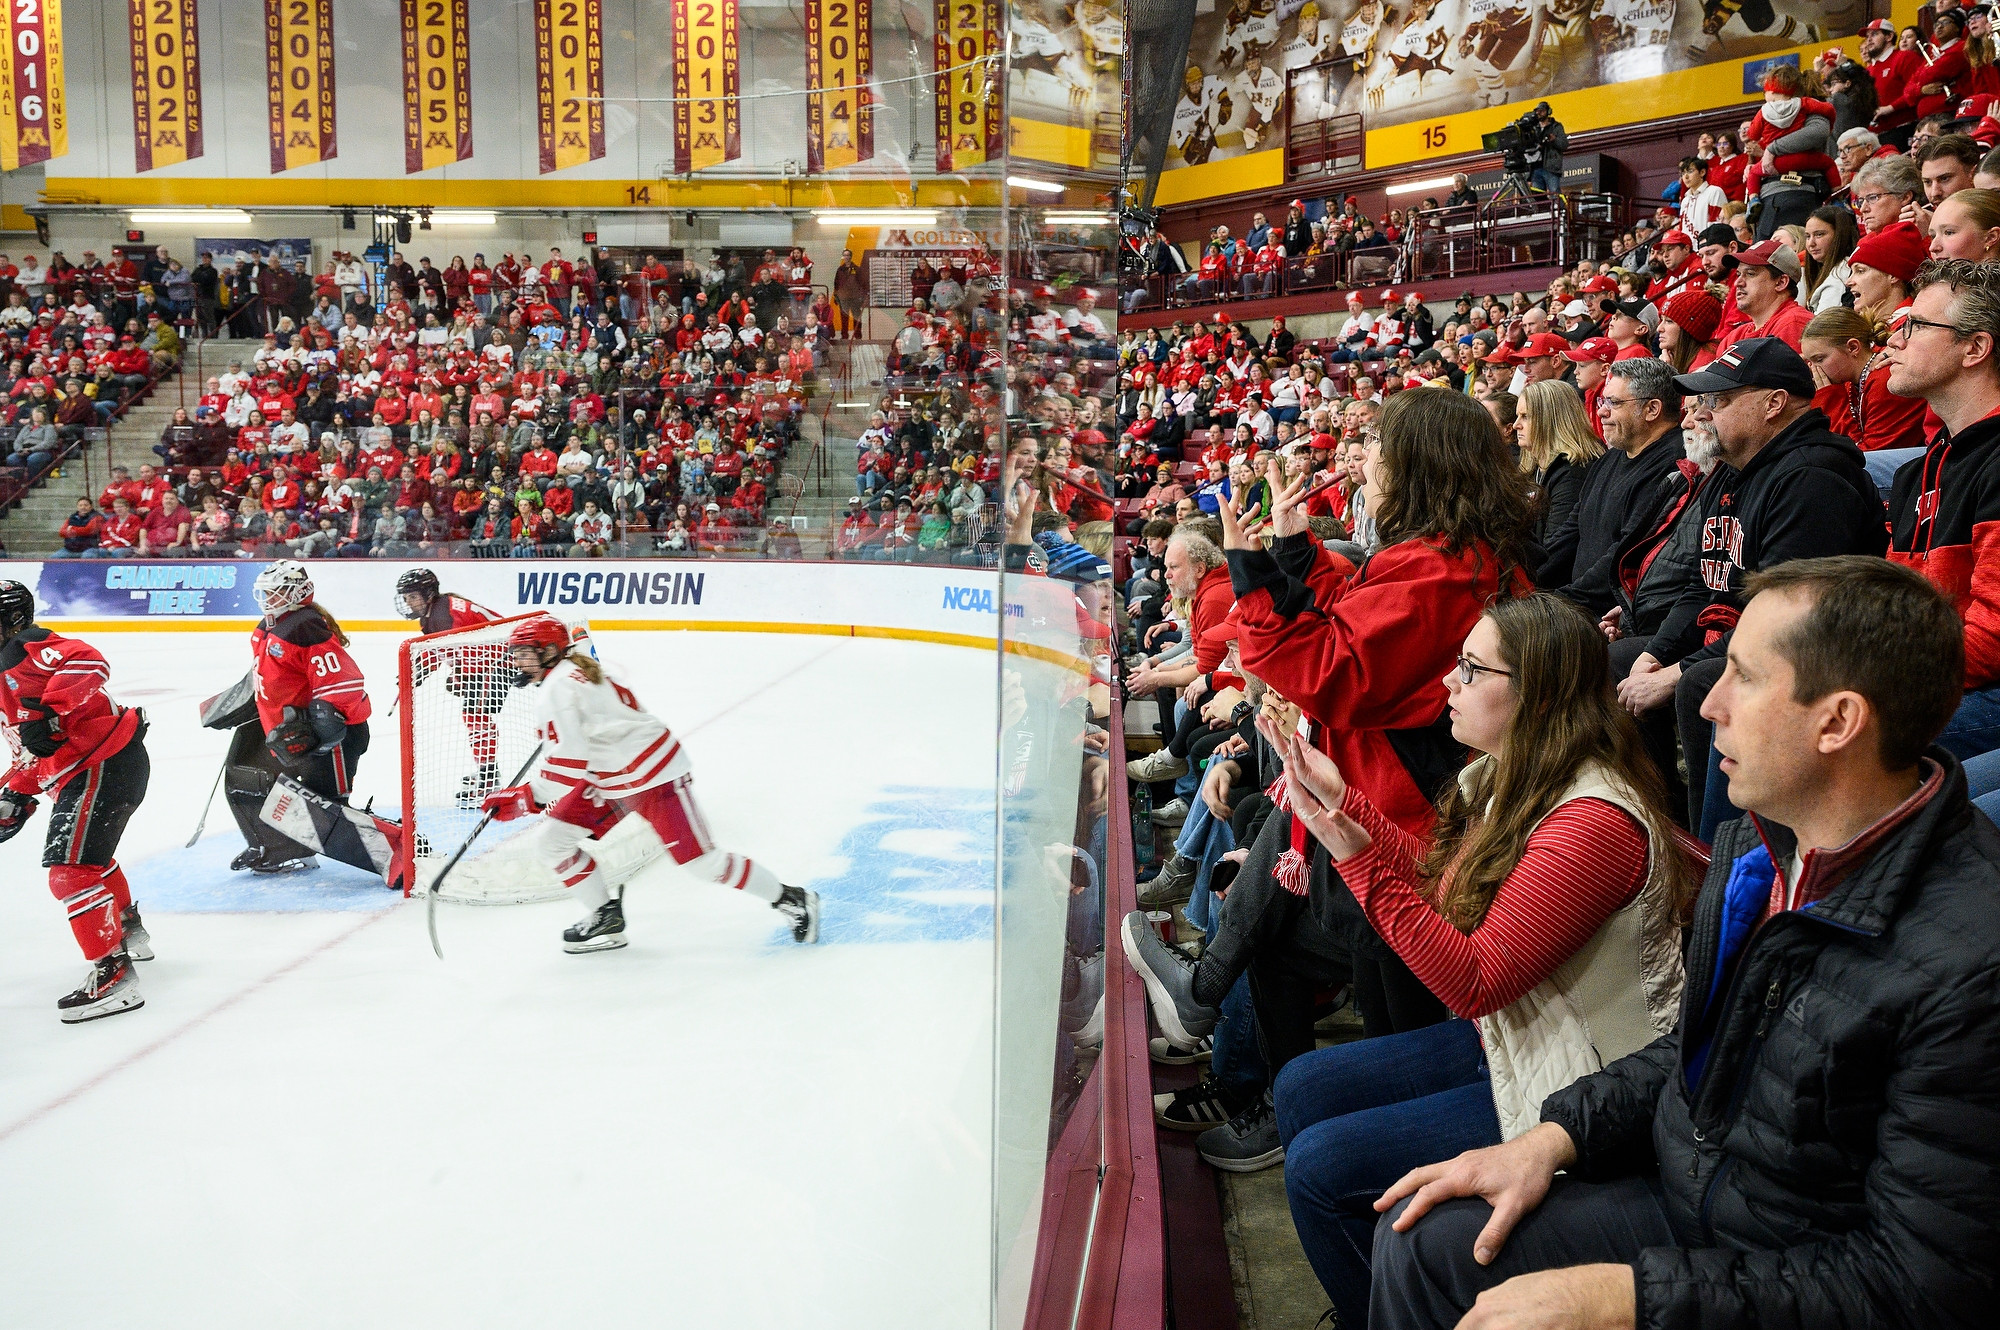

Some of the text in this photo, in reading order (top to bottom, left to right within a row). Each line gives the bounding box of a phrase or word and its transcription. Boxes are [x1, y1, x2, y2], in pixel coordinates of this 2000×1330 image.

[16, 0, 43, 121] 2016
[48, 0, 62, 130] CHAMPIONS
[133, 0, 148, 148] TOURNAMENT
[153, 0, 178, 122] 2002
[184, 0, 199, 133] CHAMPIONS
[267, 1, 281, 149] TOURNAMENT
[289, 2, 312, 122] 2004
[318, 1, 333, 134] CHAMPIONS
[405, 1, 418, 149] TOURNAMENT
[425, 2, 448, 123] 2005
[454, 1, 468, 134] CHAMPIONS
[558, 2, 581, 123] 2012
[588, 1, 601, 133] CHAMPIONS
[696, 3, 717, 124] 2013
[724, 1, 737, 134] CHAMPIONS
[829, 3, 851, 124] 2014
[858, 2, 870, 134] CHAMPIONS
[957, 4, 978, 125] 2018
[1342, 26, 1368, 38] CURTIN
[1405, 36, 1422, 46] RATY
[1622, 7, 1666, 22] SCHLEPER
[538, 1, 551, 150] TOURNAMENT
[675, 2, 688, 150] TOURNAMENT
[809, 2, 821, 150] TOURNAMENT
[937, 4, 949, 151] TOURNAMENT
[626, 186, 651, 205] 14
[1423, 125, 1447, 149] 15
[1563, 167, 1592, 178] RIDDER
[105, 565, 237, 590] CHAMPIONS
[148, 590, 207, 614] HERE
[518, 572, 705, 605] WISCONSIN
[310, 651, 342, 677] 30
[272, 793, 293, 822] STATE
[283, 778, 333, 810] CCM
